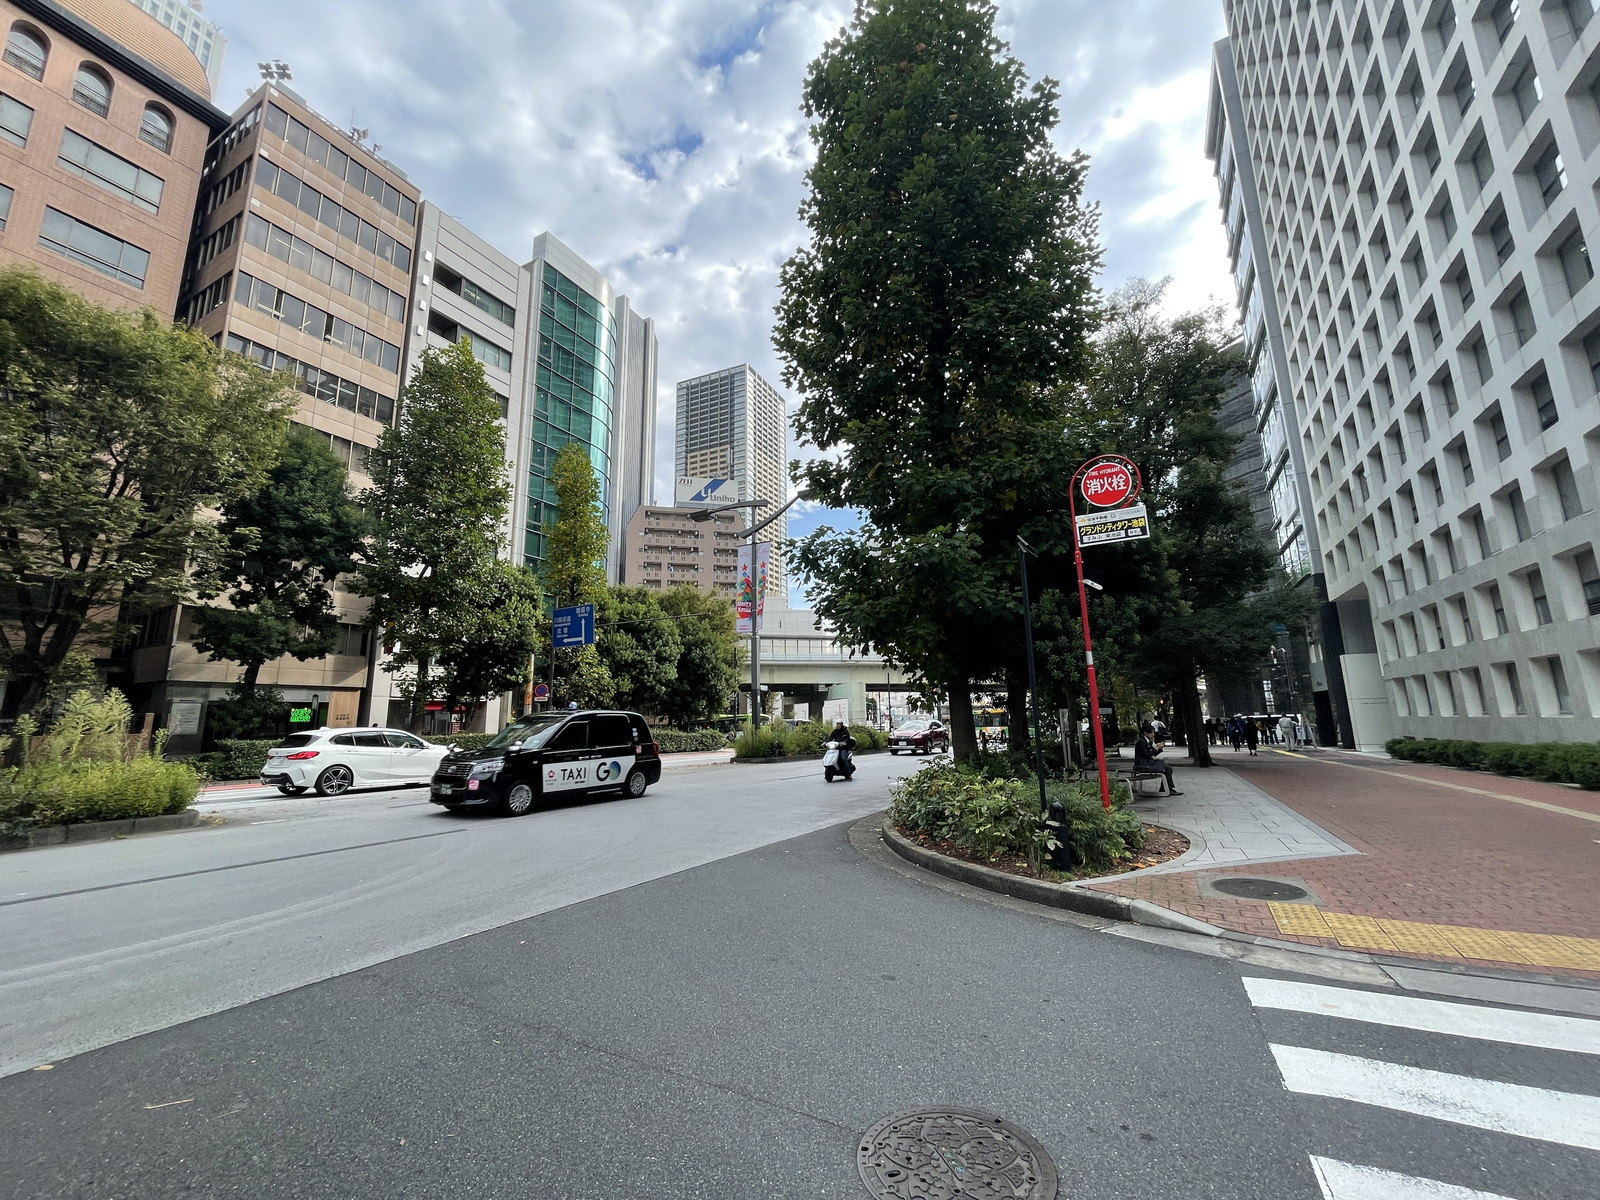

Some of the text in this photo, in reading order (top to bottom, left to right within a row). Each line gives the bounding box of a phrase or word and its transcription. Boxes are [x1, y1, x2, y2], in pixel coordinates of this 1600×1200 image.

[1086, 474, 1127, 496] 消火栓
[1080, 518, 1146, 536] グランドシティタワー池袋
[560, 761, 621, 782] TAXI GO
